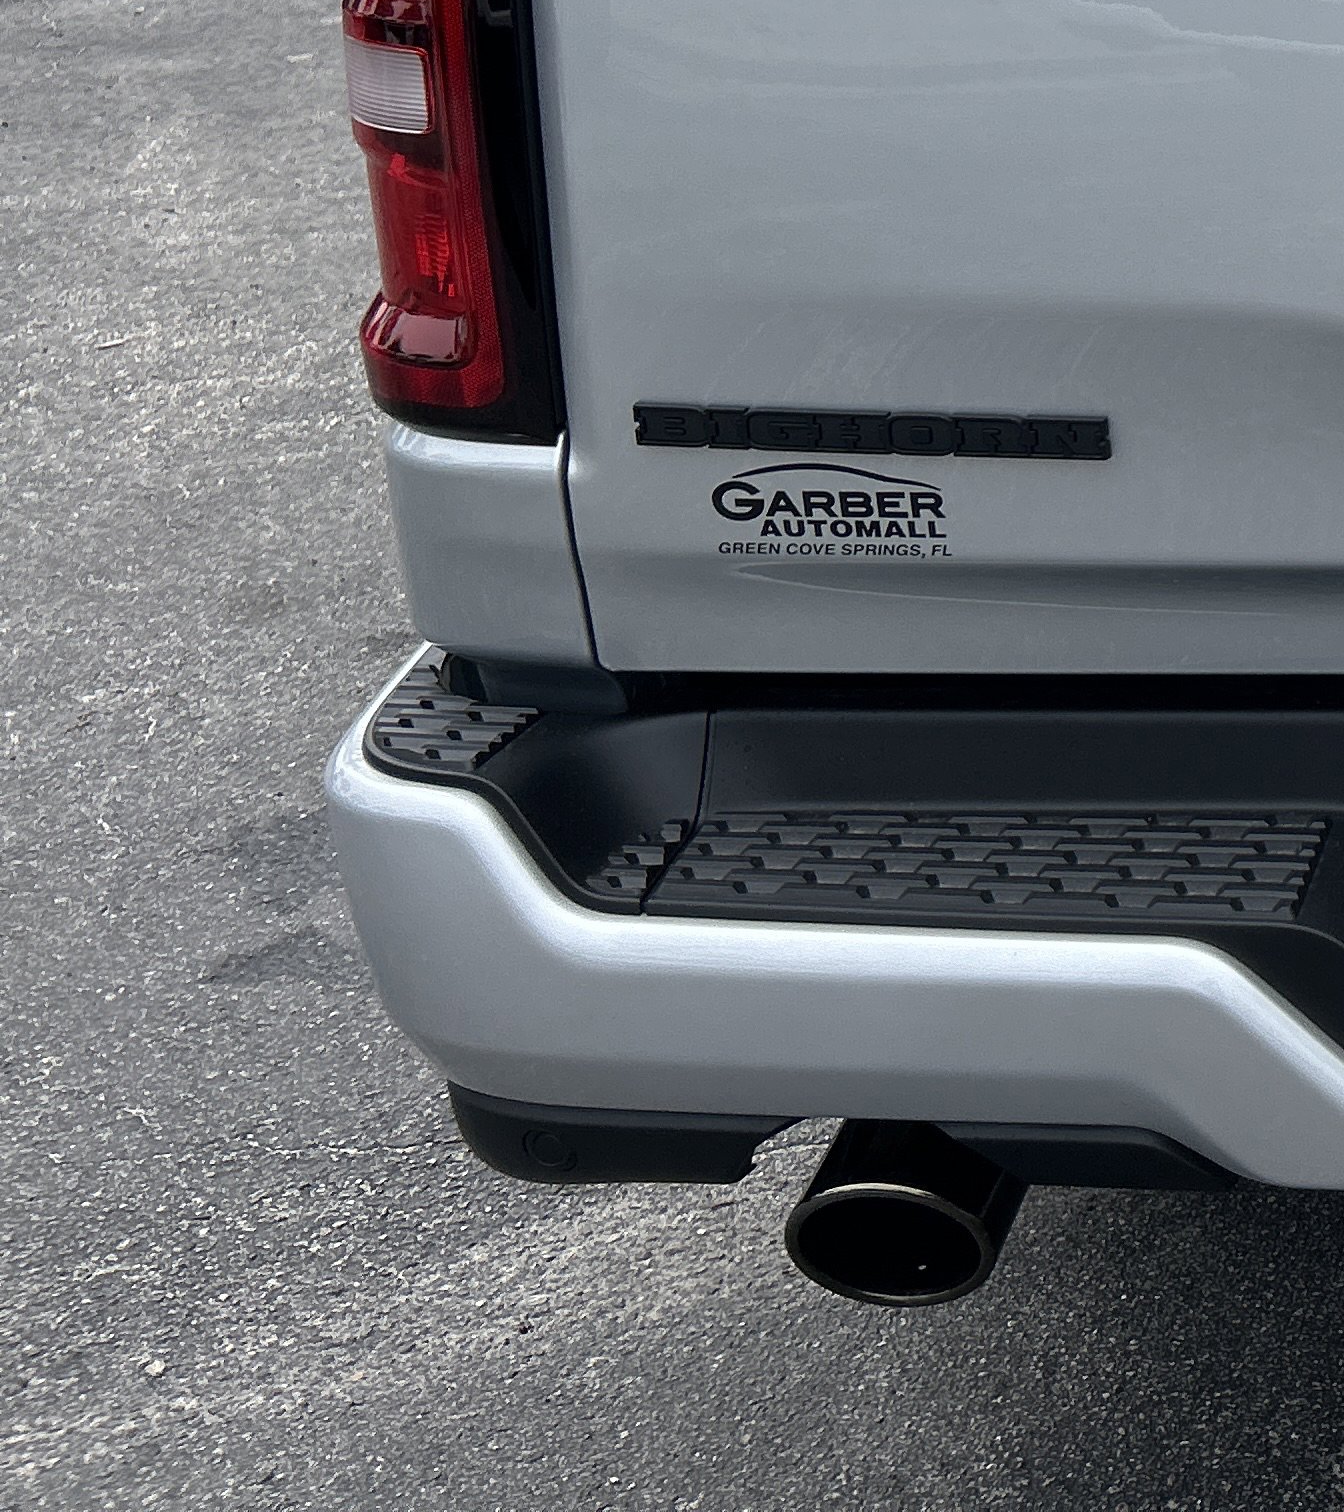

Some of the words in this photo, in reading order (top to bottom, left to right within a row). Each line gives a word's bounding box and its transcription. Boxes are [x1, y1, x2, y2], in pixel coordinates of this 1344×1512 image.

[711, 480, 946, 521] GARBER
[760, 519, 947, 538] AUTOMALL
[718, 541, 781, 555] GREEN
[786, 542, 836, 556] COVE
[841, 543, 926, 558] SPRINGS,
[931, 544, 952, 556] FL
